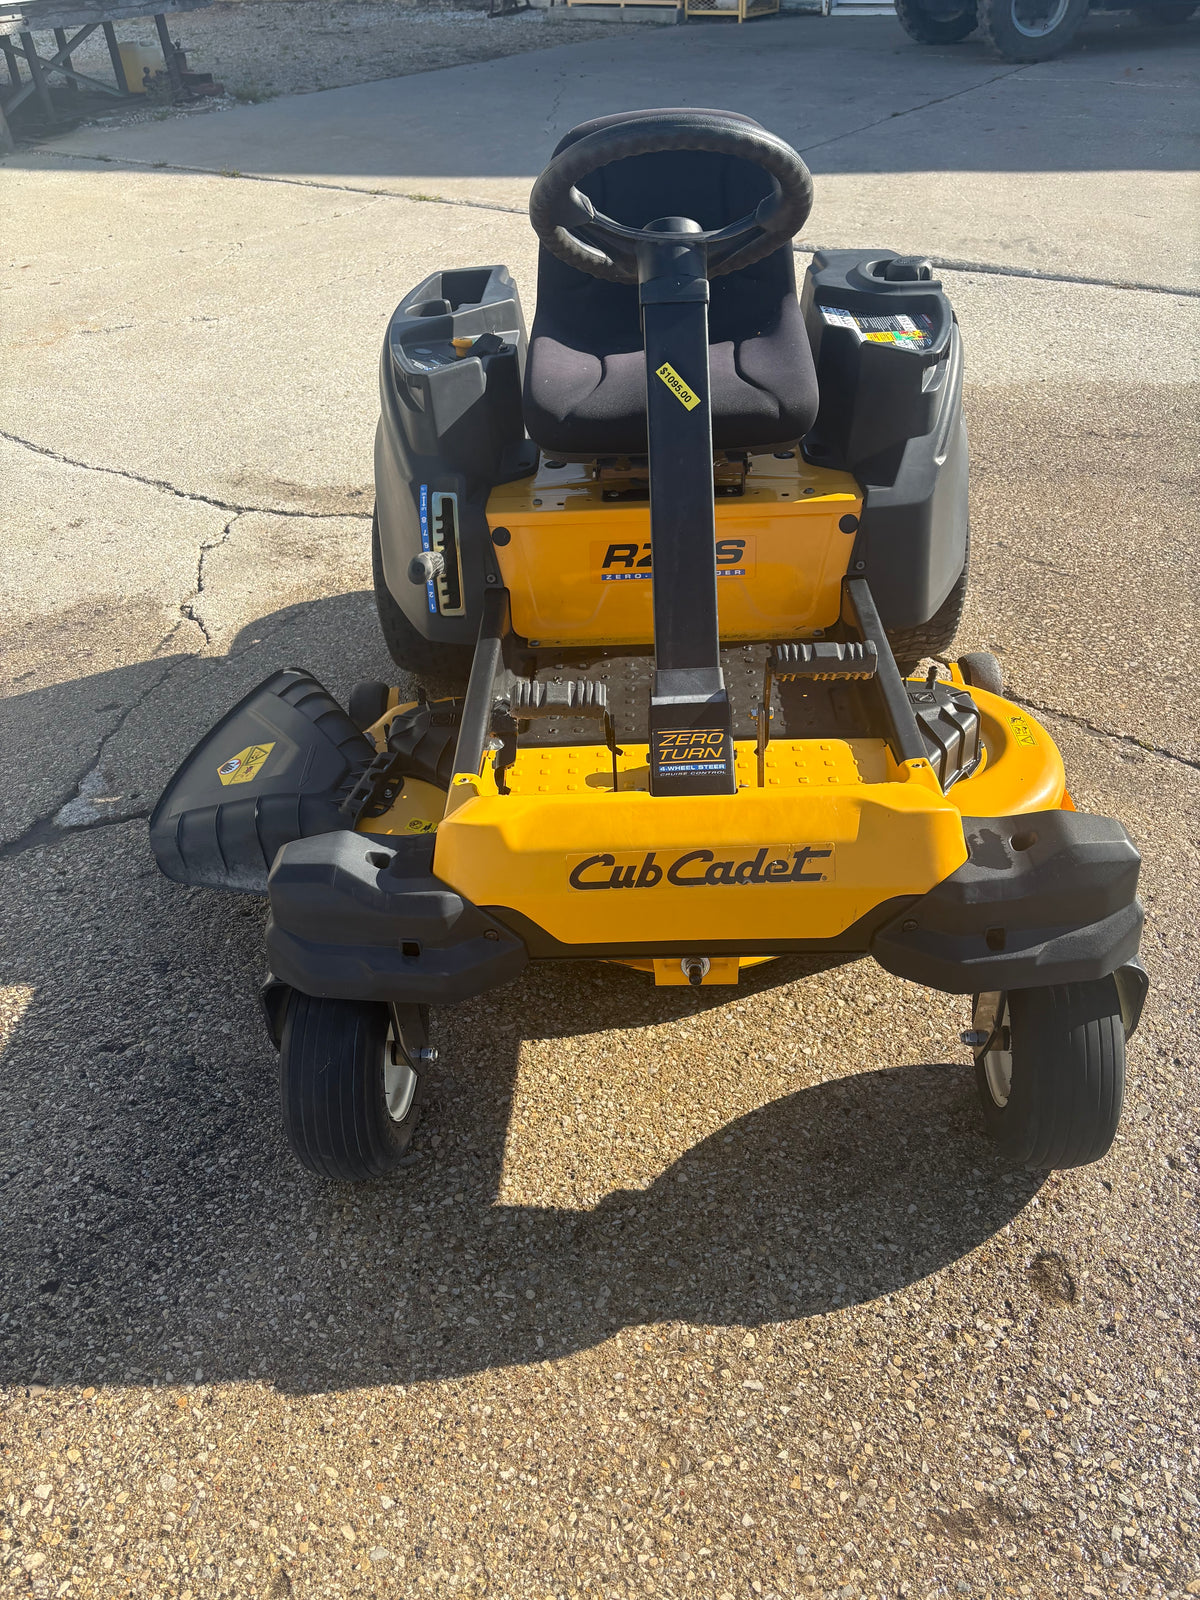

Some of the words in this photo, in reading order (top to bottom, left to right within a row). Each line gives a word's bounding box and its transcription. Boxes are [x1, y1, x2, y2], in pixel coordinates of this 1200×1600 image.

[660, 367, 692, 403] $1095.00
[659, 732, 724, 746] ZERO
[659, 747, 723, 760] TURN
[569, 852, 663, 890] Cub
[667, 846, 832, 887] Cadet
